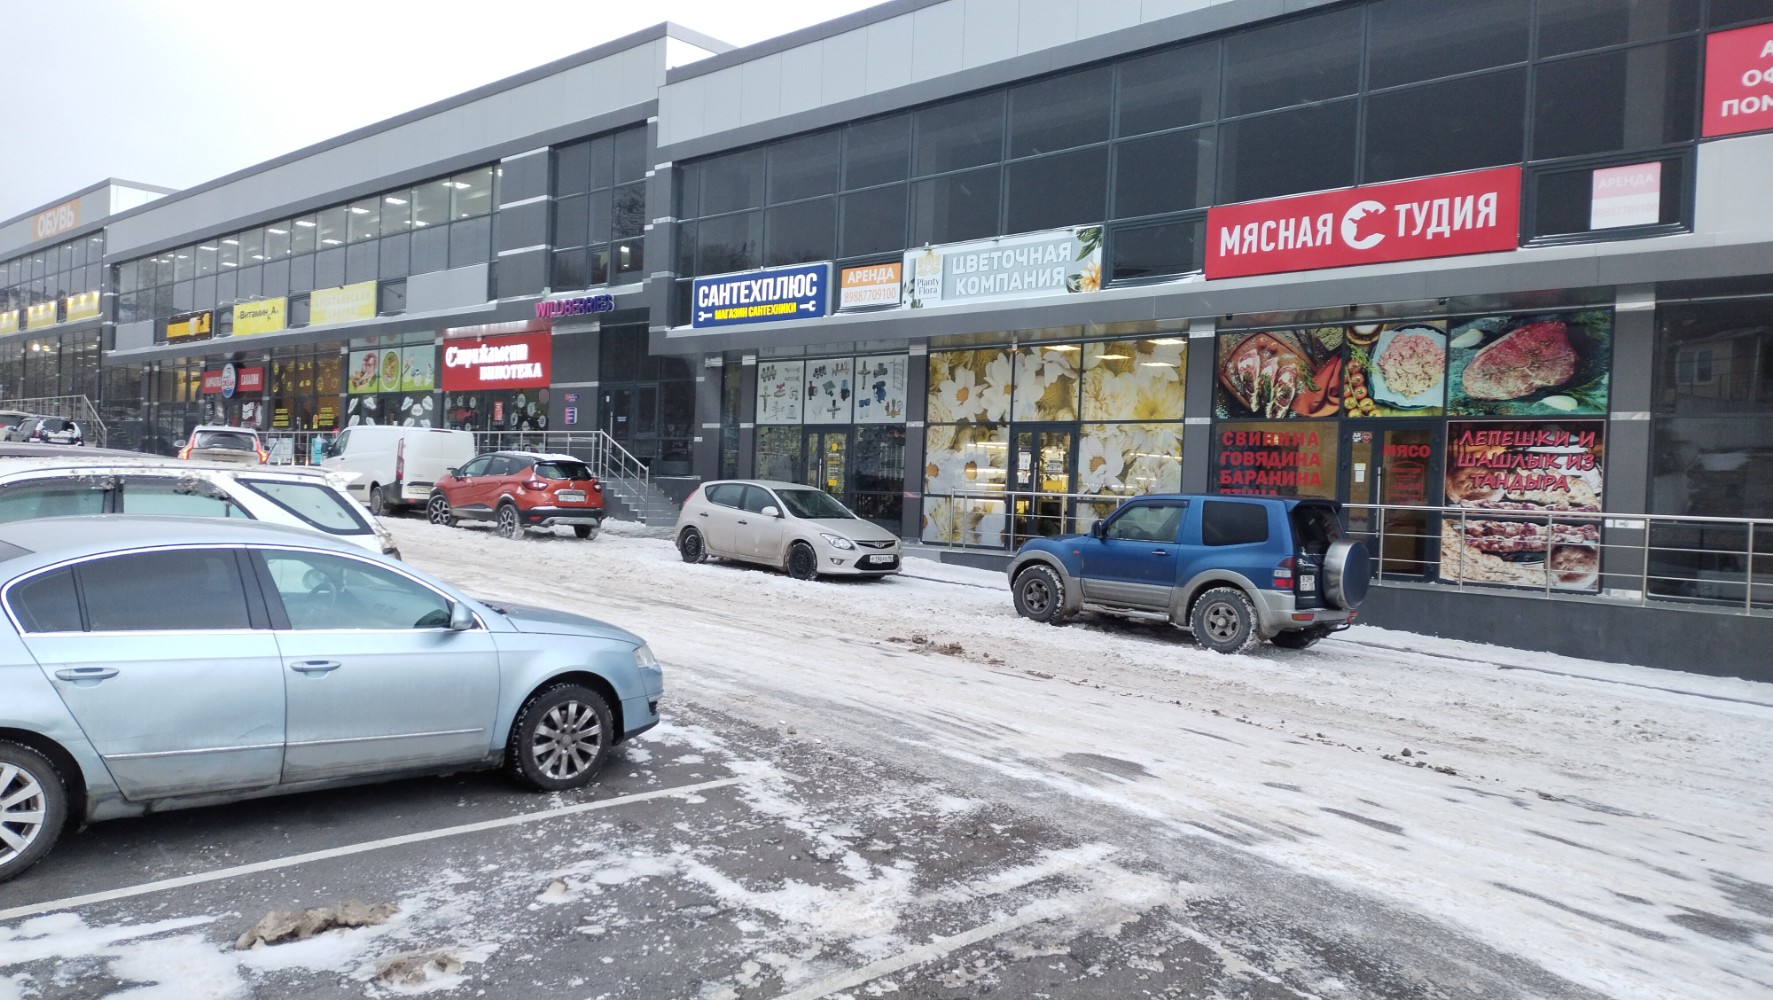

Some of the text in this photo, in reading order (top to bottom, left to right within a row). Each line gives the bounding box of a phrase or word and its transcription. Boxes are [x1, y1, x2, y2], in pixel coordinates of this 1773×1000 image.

[1598, 173, 1655, 189] АРЕНДА
[37, 204, 75, 238] ОБУВЬ
[1219, 212, 1334, 257] МЯСНАЯ
[952, 242, 1072, 275] ЦВЕТОЧНАЯ
[847, 267, 895, 284] АРЕНДА
[916, 277, 940, 287] Planty
[955, 266, 1066, 296] КОМПАНИЯ
[699, 272, 817, 308] САНТЕХПЛЮС
[844, 287, 897, 304] 89887709100
[918, 287, 938, 296] Flora
[535, 294, 614, 318] WILDBERRIES
[714, 302, 797, 320] МАГАЗИН САНТЕХНИКИ
[479, 362, 543, 381] ВИНОТЕКА
[1222, 431, 1319, 447] СВИНИНА
[1459, 429, 1596, 448] ЛЕПЕШКИ И
[1220, 451, 1322, 469] ГОВЯДИНА
[1382, 444, 1431, 458] МЯСО
[1457, 452, 1595, 471] ШАШЛЫК ИЗ
[1220, 469, 1323, 488] БАРАНИНА
[1470, 474, 1570, 494] ТАНДЫРА
